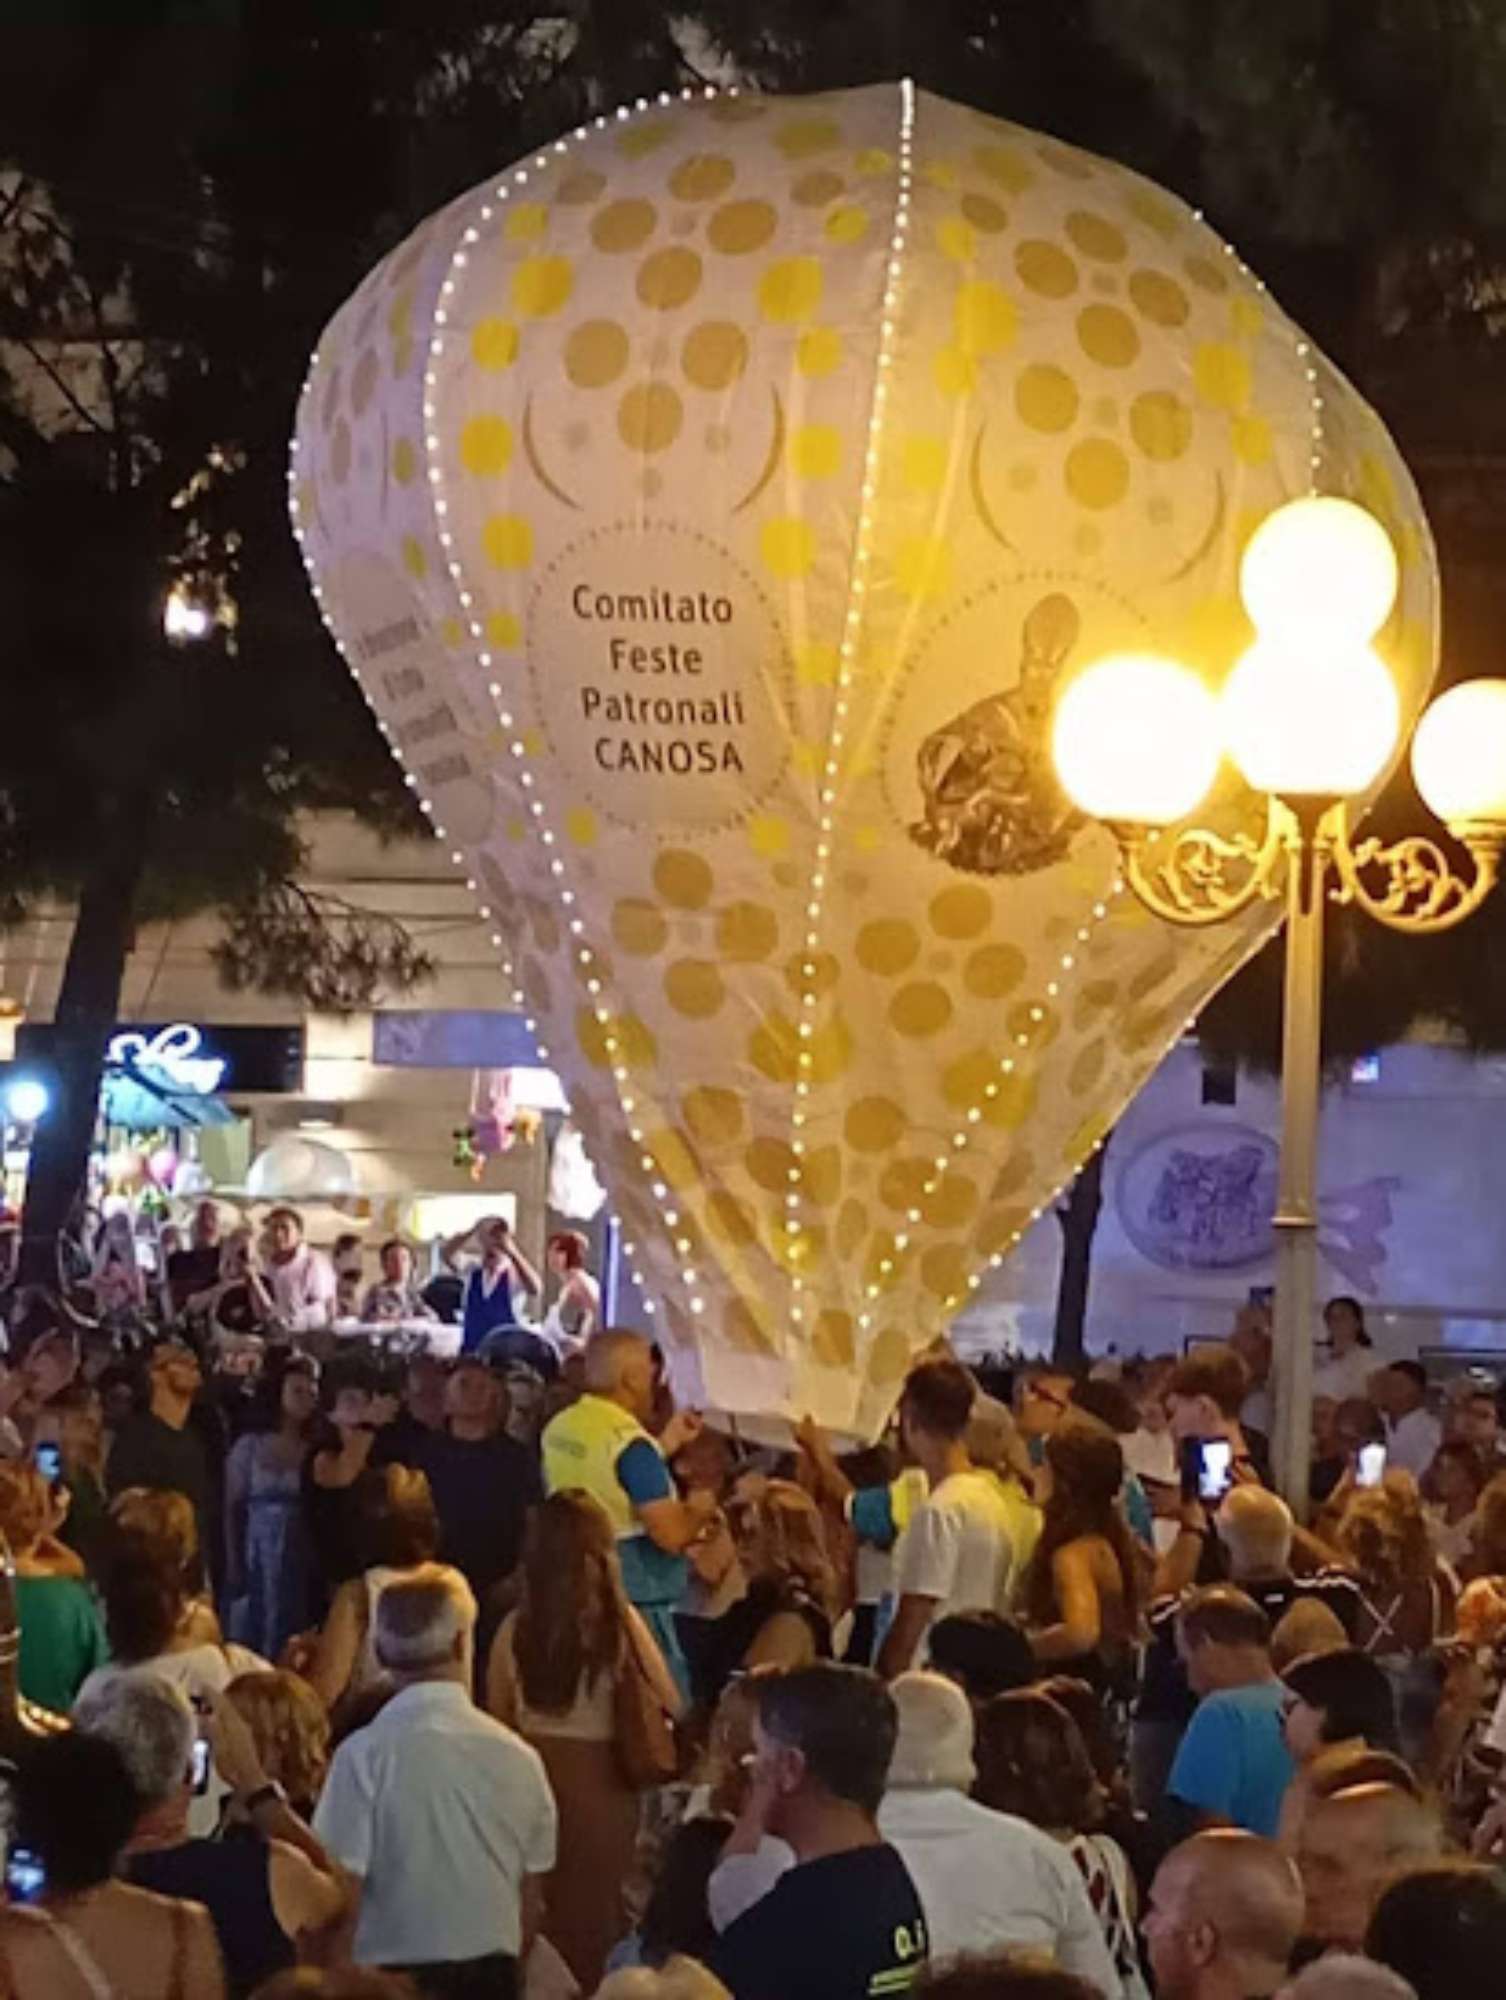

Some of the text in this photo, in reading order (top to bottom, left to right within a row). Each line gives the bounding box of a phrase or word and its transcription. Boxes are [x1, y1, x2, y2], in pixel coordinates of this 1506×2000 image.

[572, 584, 733, 624] Comitato
[608, 638, 703, 674] Feste
[581, 686, 745, 725] Patronali
[594, 737, 744, 775] CANOSA
